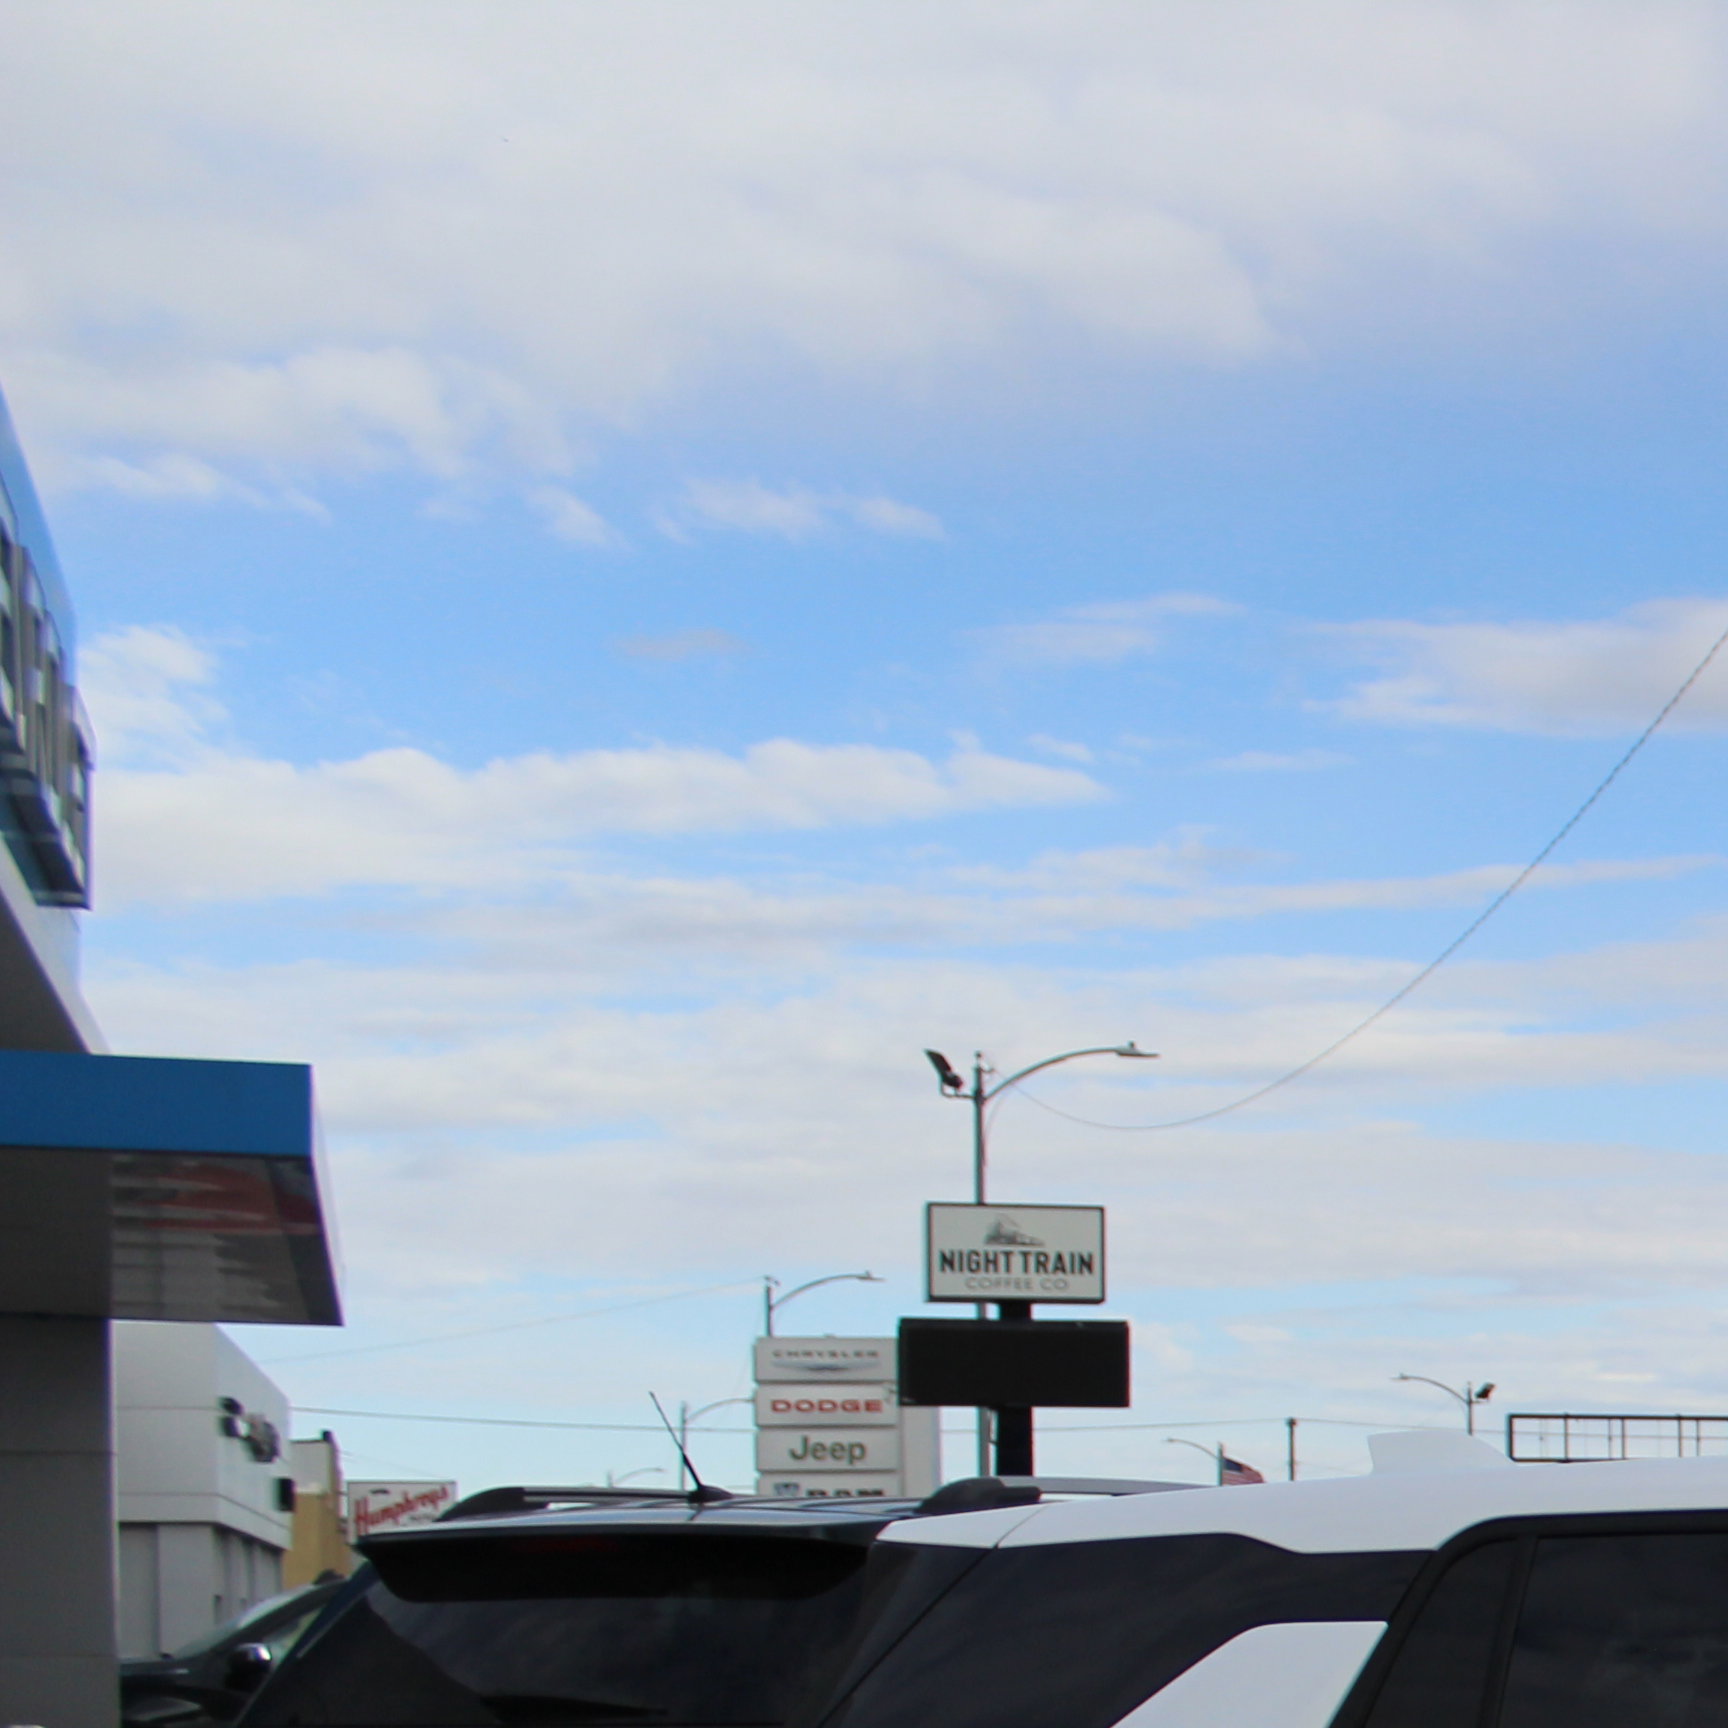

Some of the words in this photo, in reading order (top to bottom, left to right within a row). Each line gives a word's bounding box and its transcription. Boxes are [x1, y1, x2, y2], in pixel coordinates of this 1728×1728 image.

[939, 1250, 1015, 1273] NIGHT
[1018, 1250, 1094, 1275] TRAIN
[965, 1277, 1033, 1290] COFFEE
[772, 1350, 879, 1359] CHRYSLER
[771, 1399, 884, 1413] DODGE
[788, 1435, 868, 1465] Jeep
